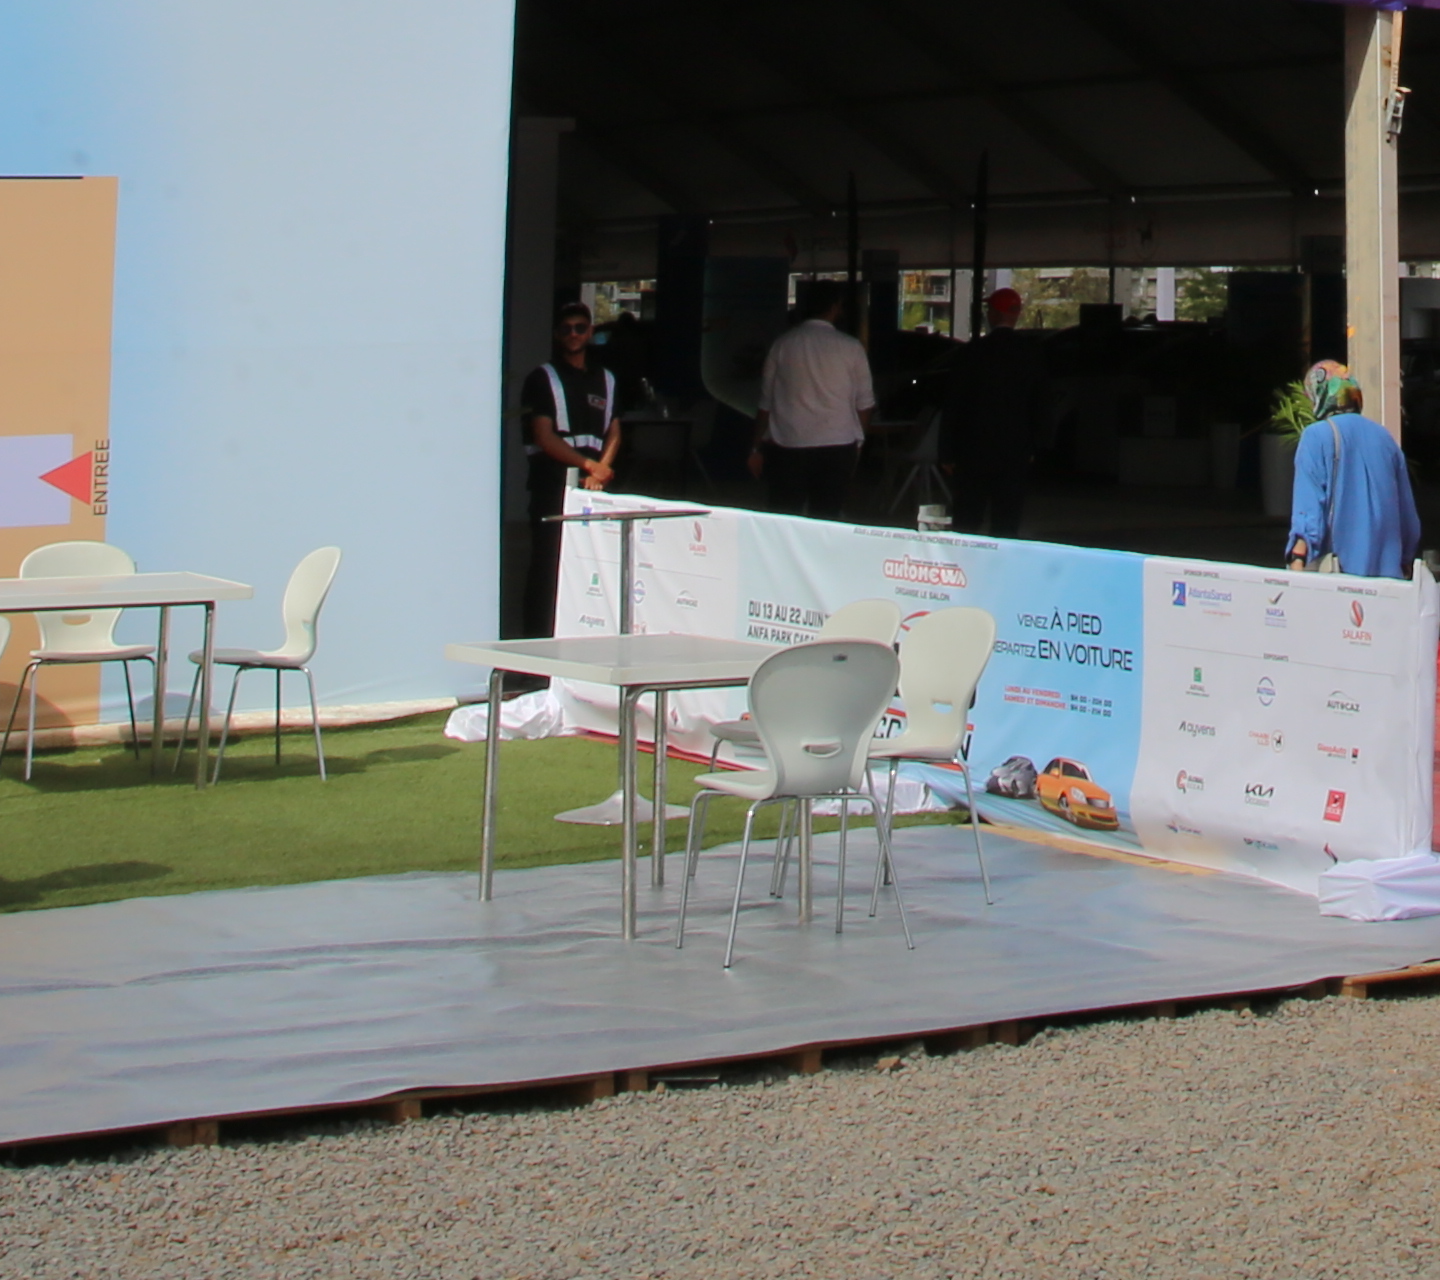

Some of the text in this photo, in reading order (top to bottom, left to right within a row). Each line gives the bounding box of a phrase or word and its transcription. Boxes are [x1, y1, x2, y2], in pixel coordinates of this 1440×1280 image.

[93, 439, 109, 515] ENTREE
[749, 601, 824, 628] DU 13 AU 22 JUIN
[1017, 606, 1102, 636] VENEZ À PIED
[747, 625, 768, 640] ANFA
[770, 628, 791, 644] PARK
[1342, 629, 1372, 641] SALAFIN
[1038, 640, 1060, 661] EN
[1064, 642, 1133, 671] VOITURE
